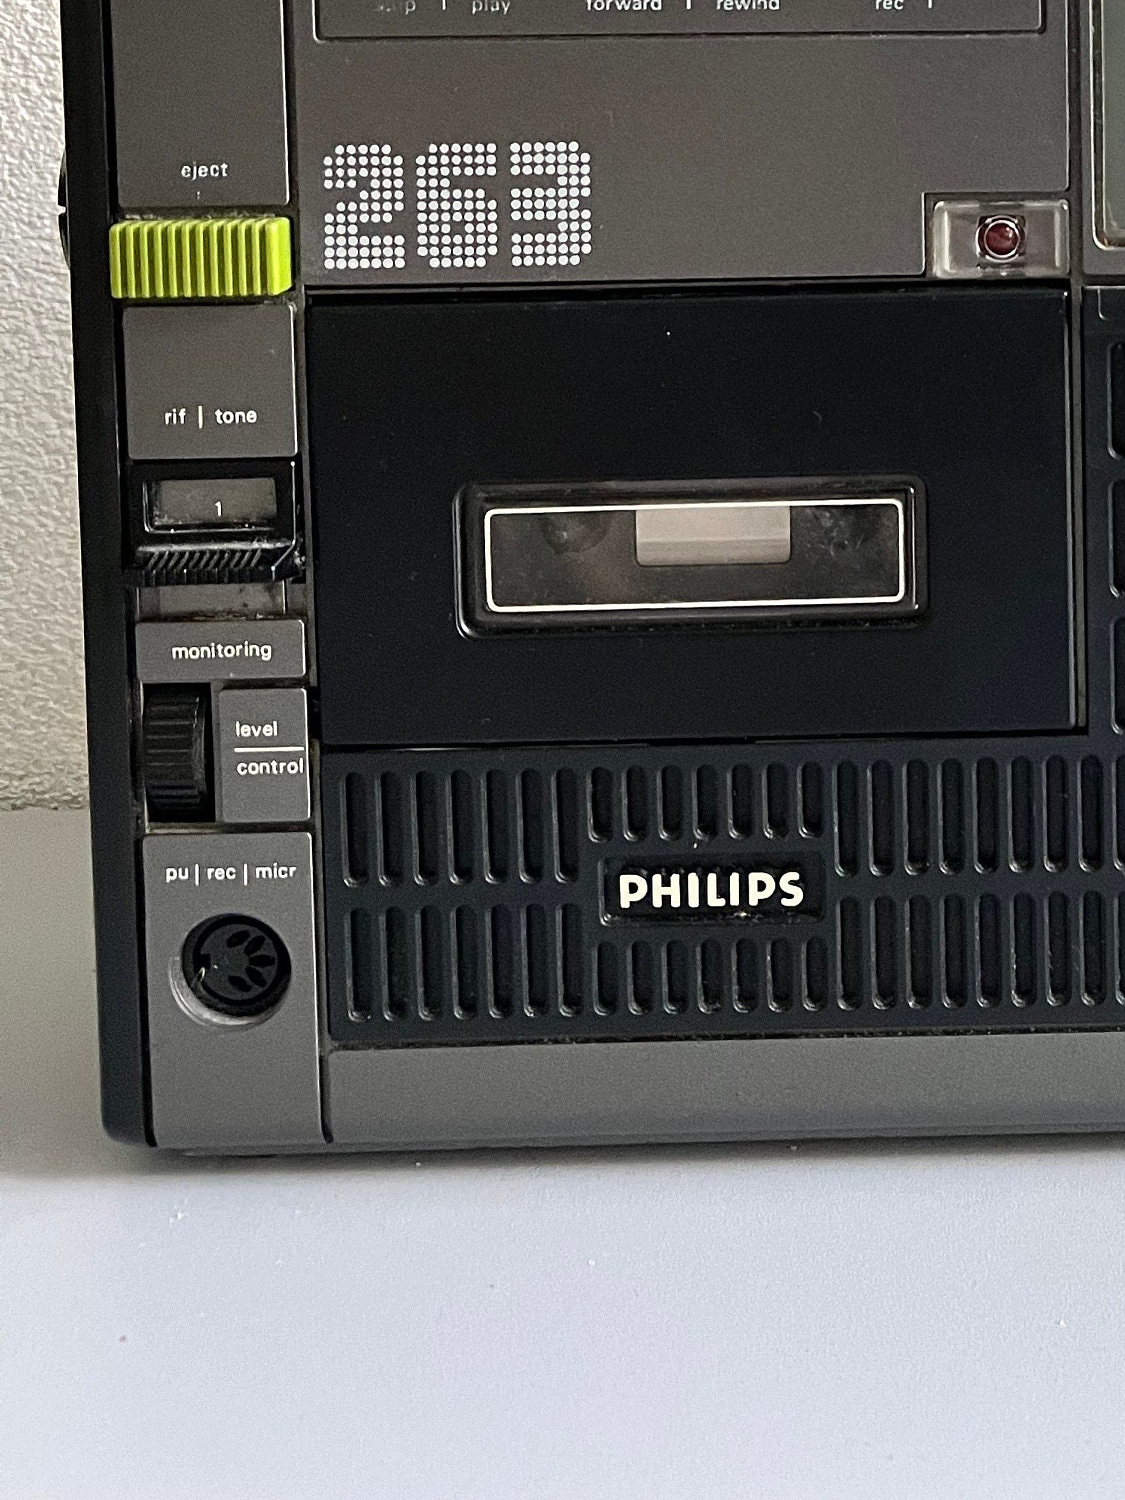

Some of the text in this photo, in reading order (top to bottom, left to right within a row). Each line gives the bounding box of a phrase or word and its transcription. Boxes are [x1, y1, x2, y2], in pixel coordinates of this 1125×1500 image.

[180, 163, 228, 180] eject
[324, 142, 591, 269] 263
[164, 408, 257, 425] rif tone
[215, 501, 222, 517] 1
[171, 641, 272, 661] monitoring
[235, 720, 278, 737] level
[236, 757, 304, 775] control
[166, 862, 297, 883] pu rec micr
[619, 871, 804, 909] PHILIPS
